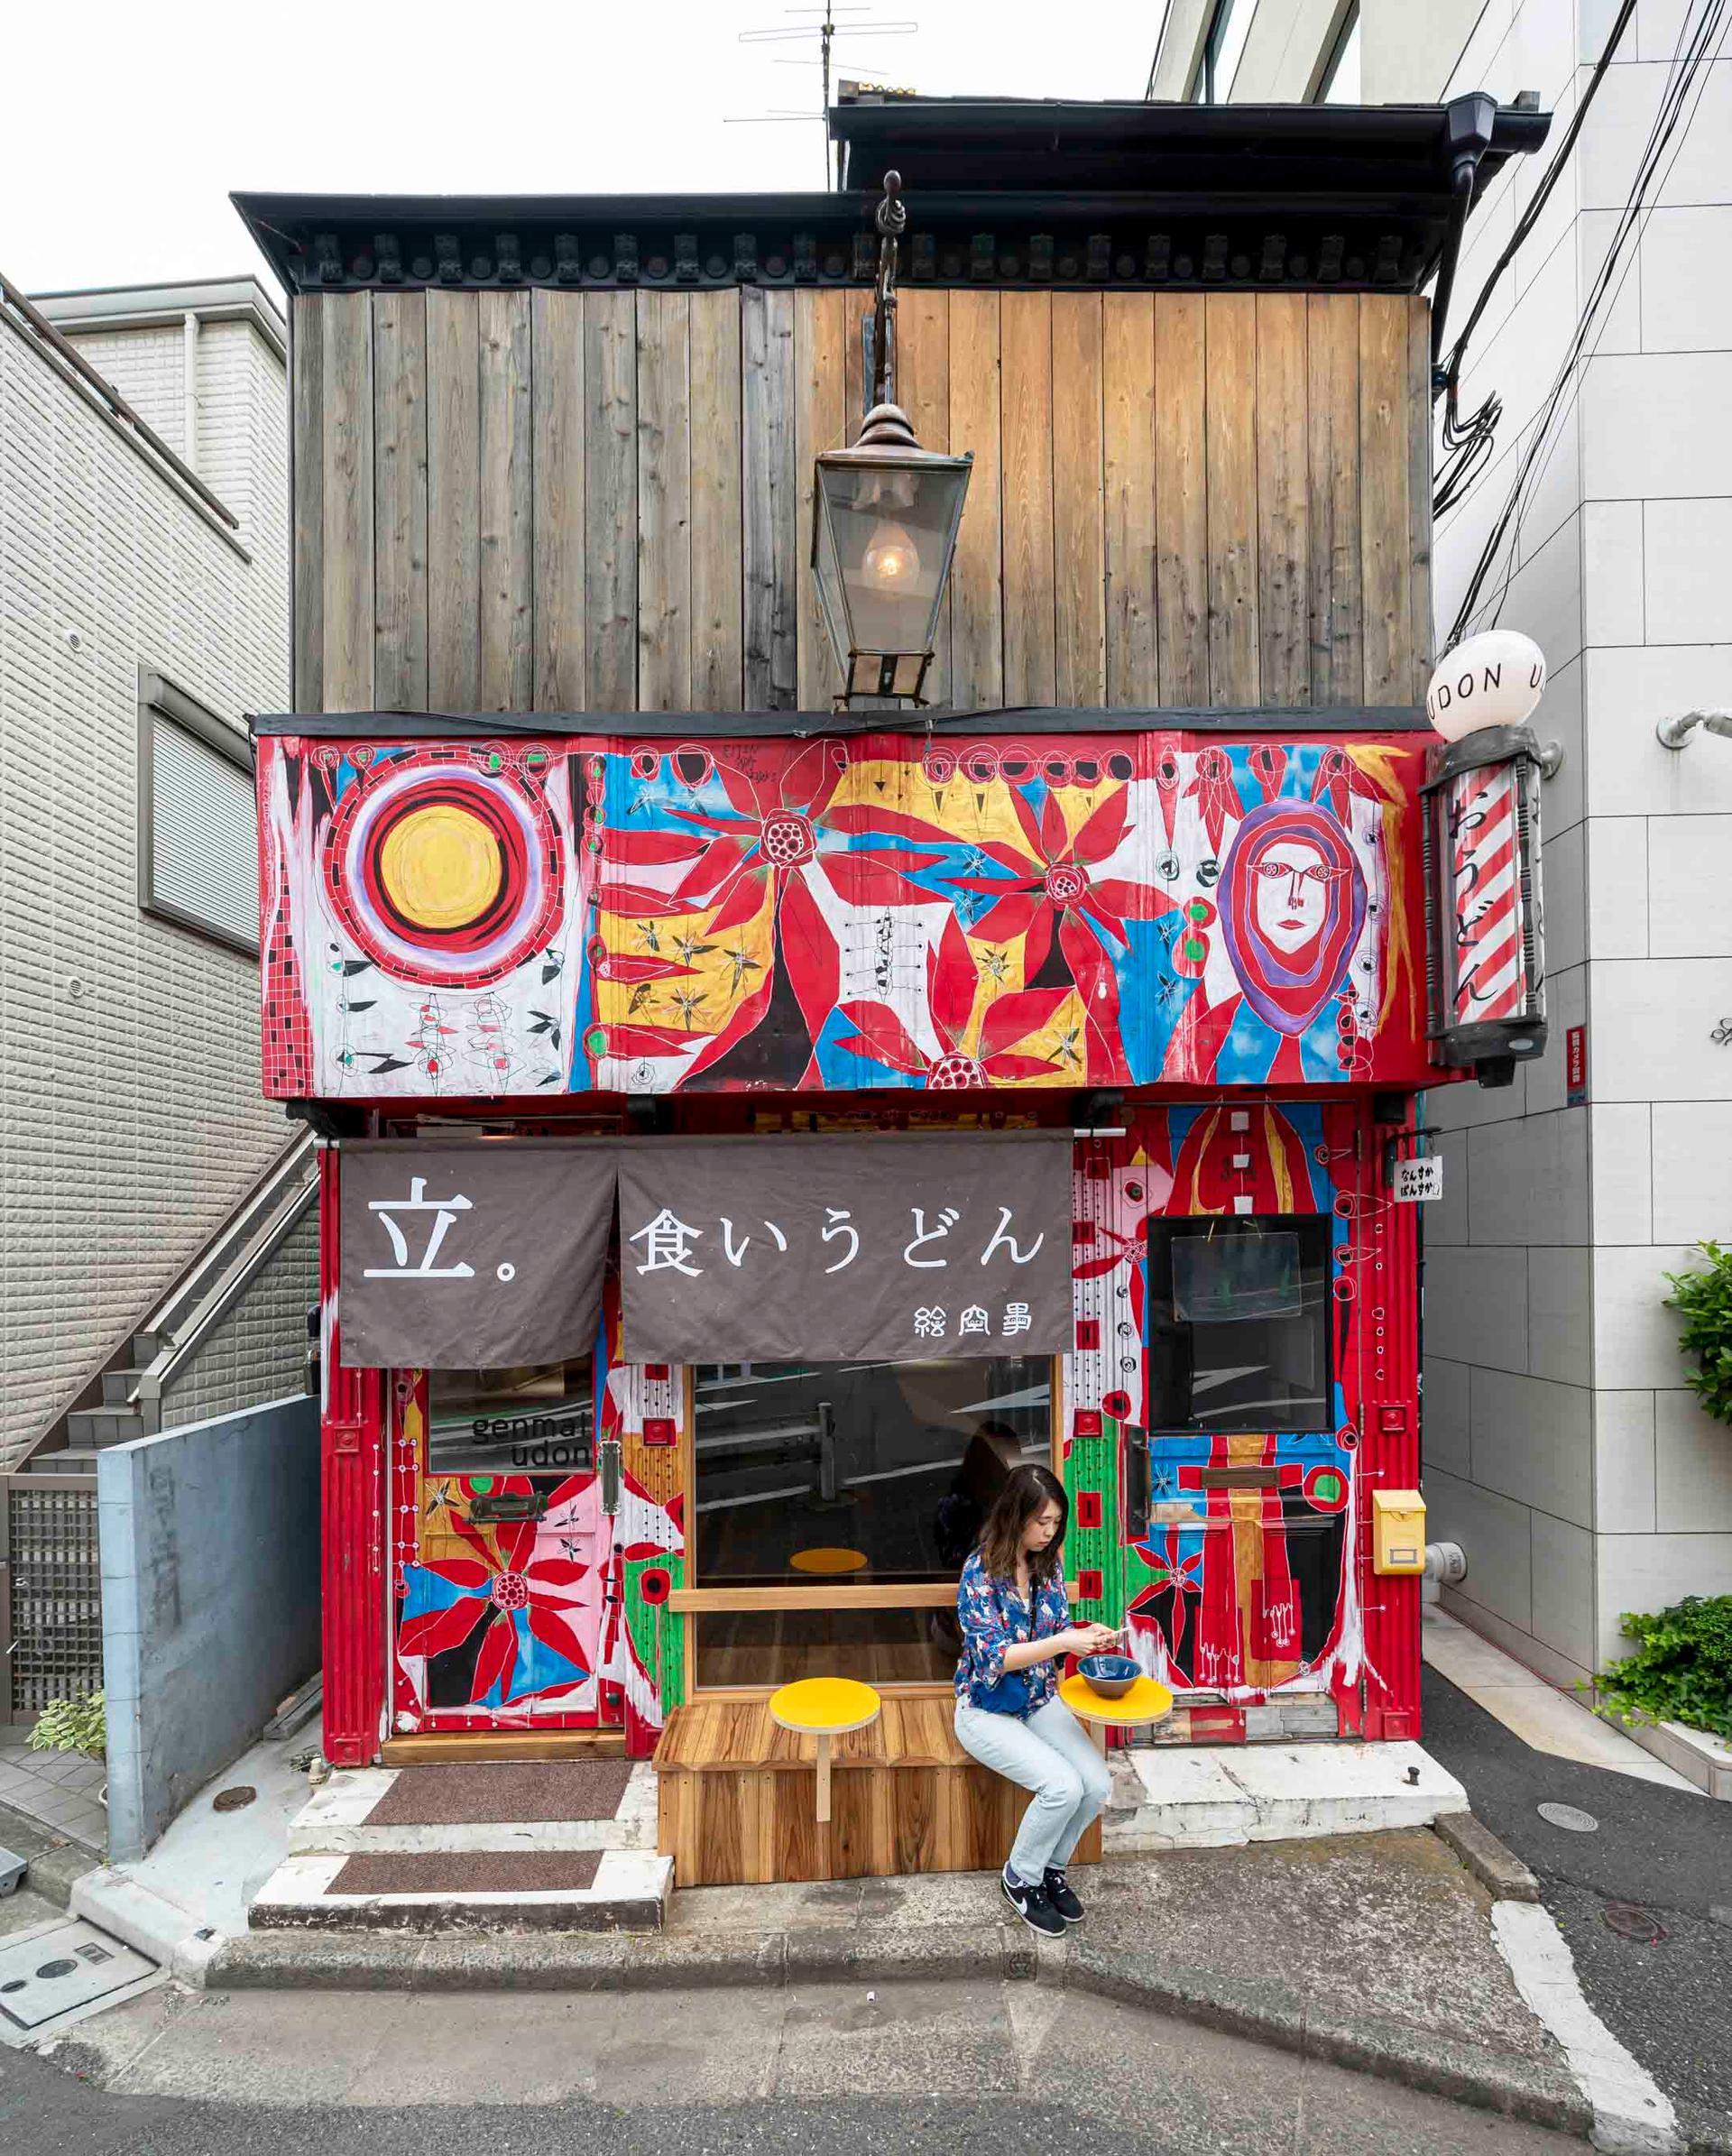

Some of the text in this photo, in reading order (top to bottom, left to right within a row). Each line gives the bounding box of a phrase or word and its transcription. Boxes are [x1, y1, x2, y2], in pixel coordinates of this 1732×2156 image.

[1427, 663, 1501, 720] UDON
[364, 1177, 1045, 1282] 立。 食いうどん
[511, 1440, 591, 1466] udon
